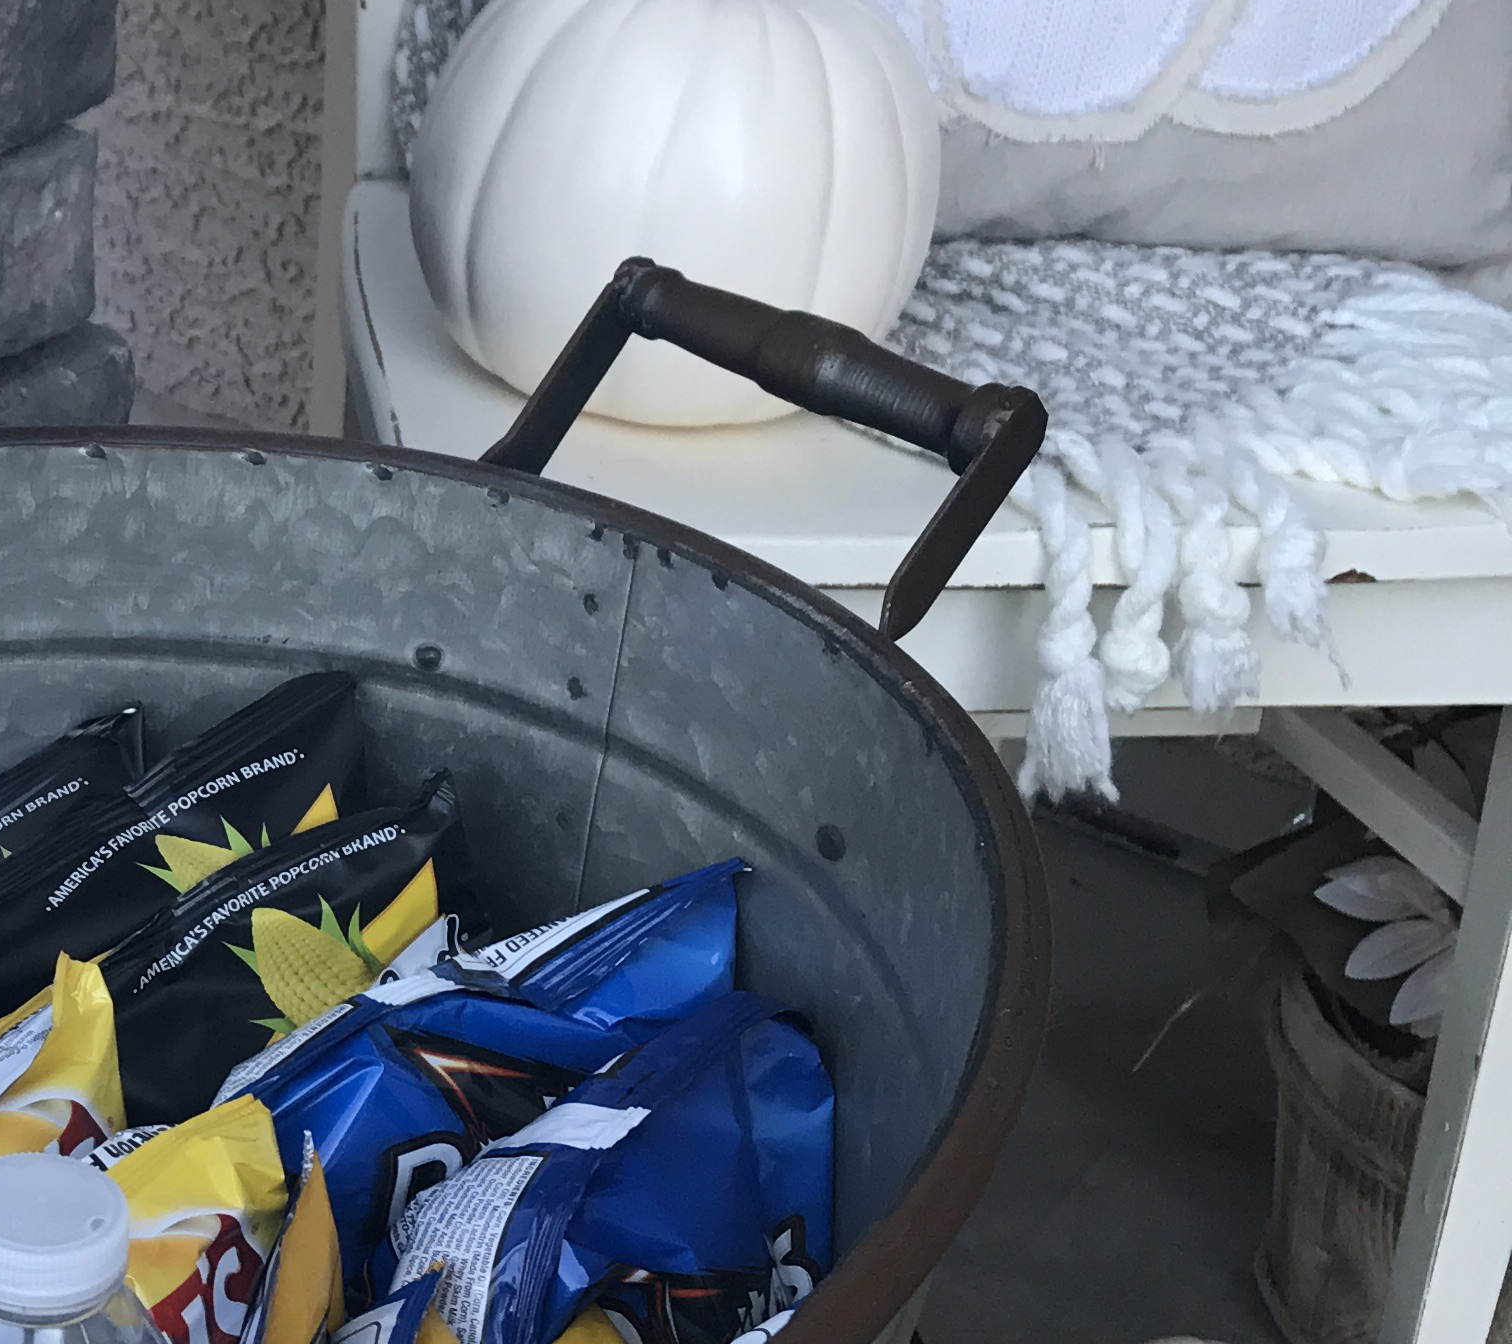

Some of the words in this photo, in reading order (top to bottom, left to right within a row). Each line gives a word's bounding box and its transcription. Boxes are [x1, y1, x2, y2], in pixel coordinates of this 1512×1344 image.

[48, 842, 113, 909] AMERICA'S
[107, 809, 171, 853] FAVORITE
[167, 771, 241, 818] POPCORN
[139, 924, 209, 990] AMERICA'S
[202, 882, 271, 930] FAVORITE
[268, 849, 341, 893] POPCORN
[462, 1276, 475, 1299] From
